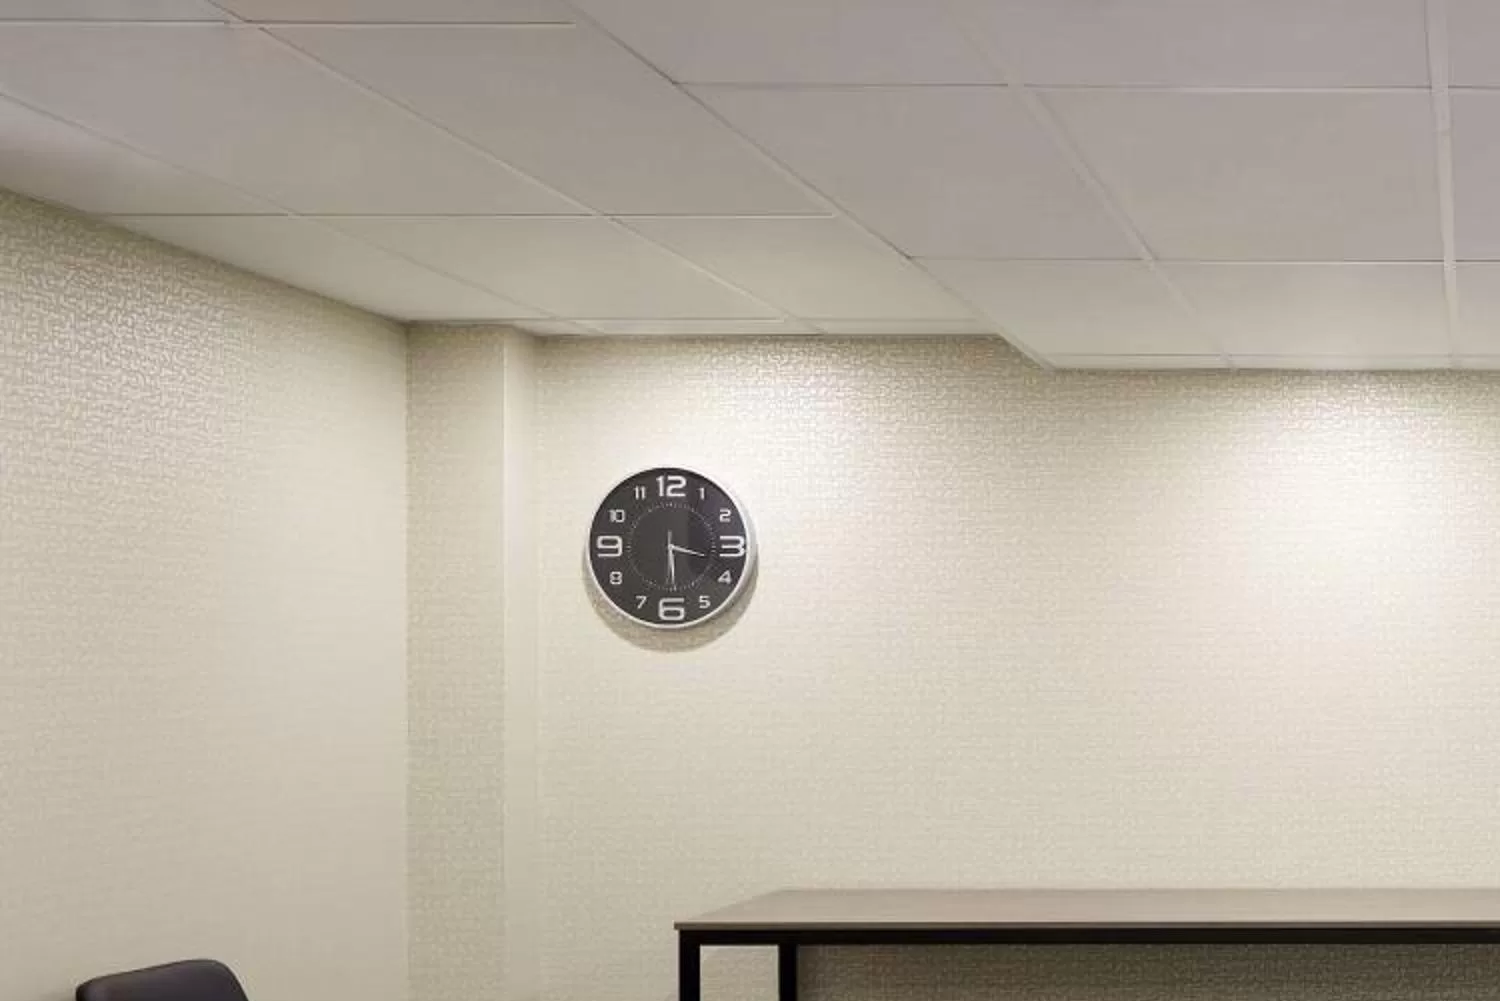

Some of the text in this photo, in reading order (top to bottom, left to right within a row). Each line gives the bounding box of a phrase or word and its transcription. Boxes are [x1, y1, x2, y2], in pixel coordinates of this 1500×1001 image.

[633, 486, 647, 500] 11
[655, 475, 688, 498] 12
[698, 487, 706, 500] 1
[609, 508, 626, 523] 10
[719, 508, 732, 523] 2
[595, 535, 623, 558] 9
[719, 535, 746, 558] 3
[609, 571, 623, 585] 8
[717, 570, 732, 585] 4
[635, 595, 648, 609] 7
[658, 597, 686, 621] 6
[698, 595, 711, 609] 5
